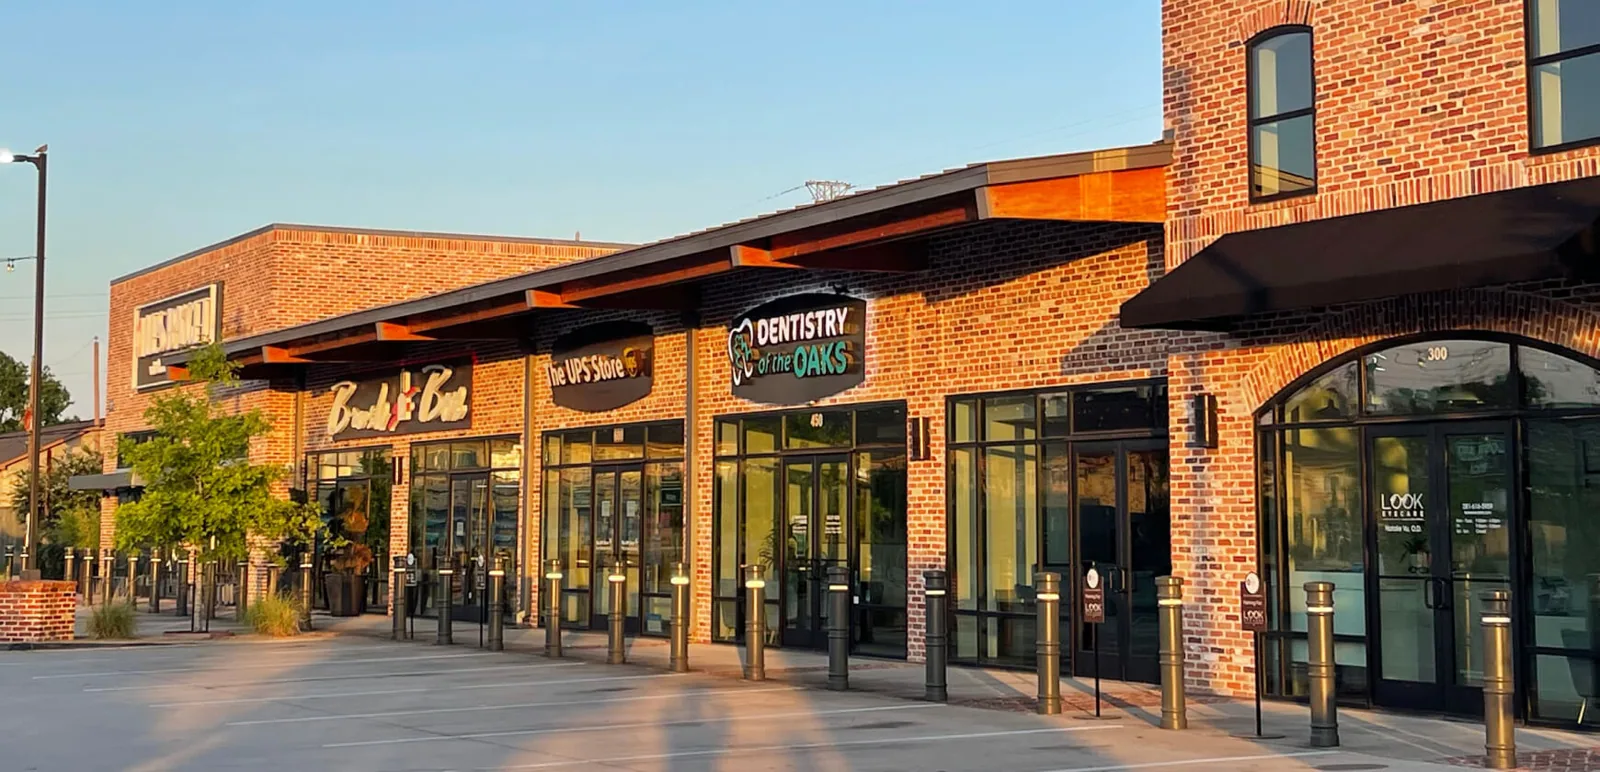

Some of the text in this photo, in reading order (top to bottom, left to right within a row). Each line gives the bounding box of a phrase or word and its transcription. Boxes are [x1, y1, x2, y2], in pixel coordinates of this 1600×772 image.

[757, 307, 848, 346] DENTISTRY
[758, 341, 847, 378] of the OAKS
[1427, 346, 1448, 361] 300
[545, 355, 625, 387] The UPS Store
[810, 413, 824, 427] 450
[1381, 493, 1424, 510] LOOK
[1243, 610, 1263, 620] LOOK
